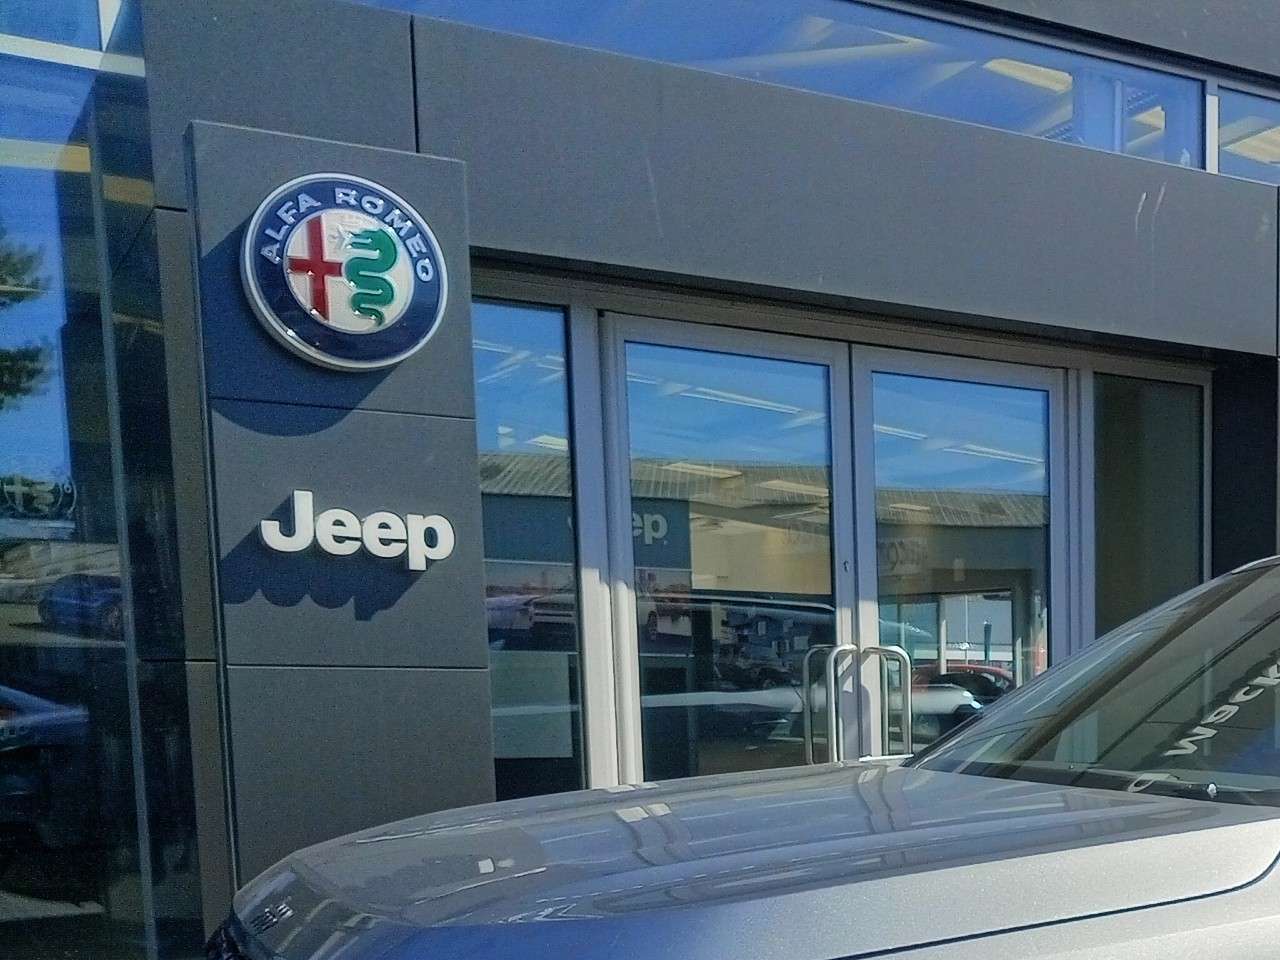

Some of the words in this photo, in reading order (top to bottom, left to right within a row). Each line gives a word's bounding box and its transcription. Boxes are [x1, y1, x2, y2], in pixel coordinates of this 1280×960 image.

[260, 192, 322, 265] ALFA
[334, 187, 434, 282] ROMEO
[260, 489, 455, 571] Jeep
